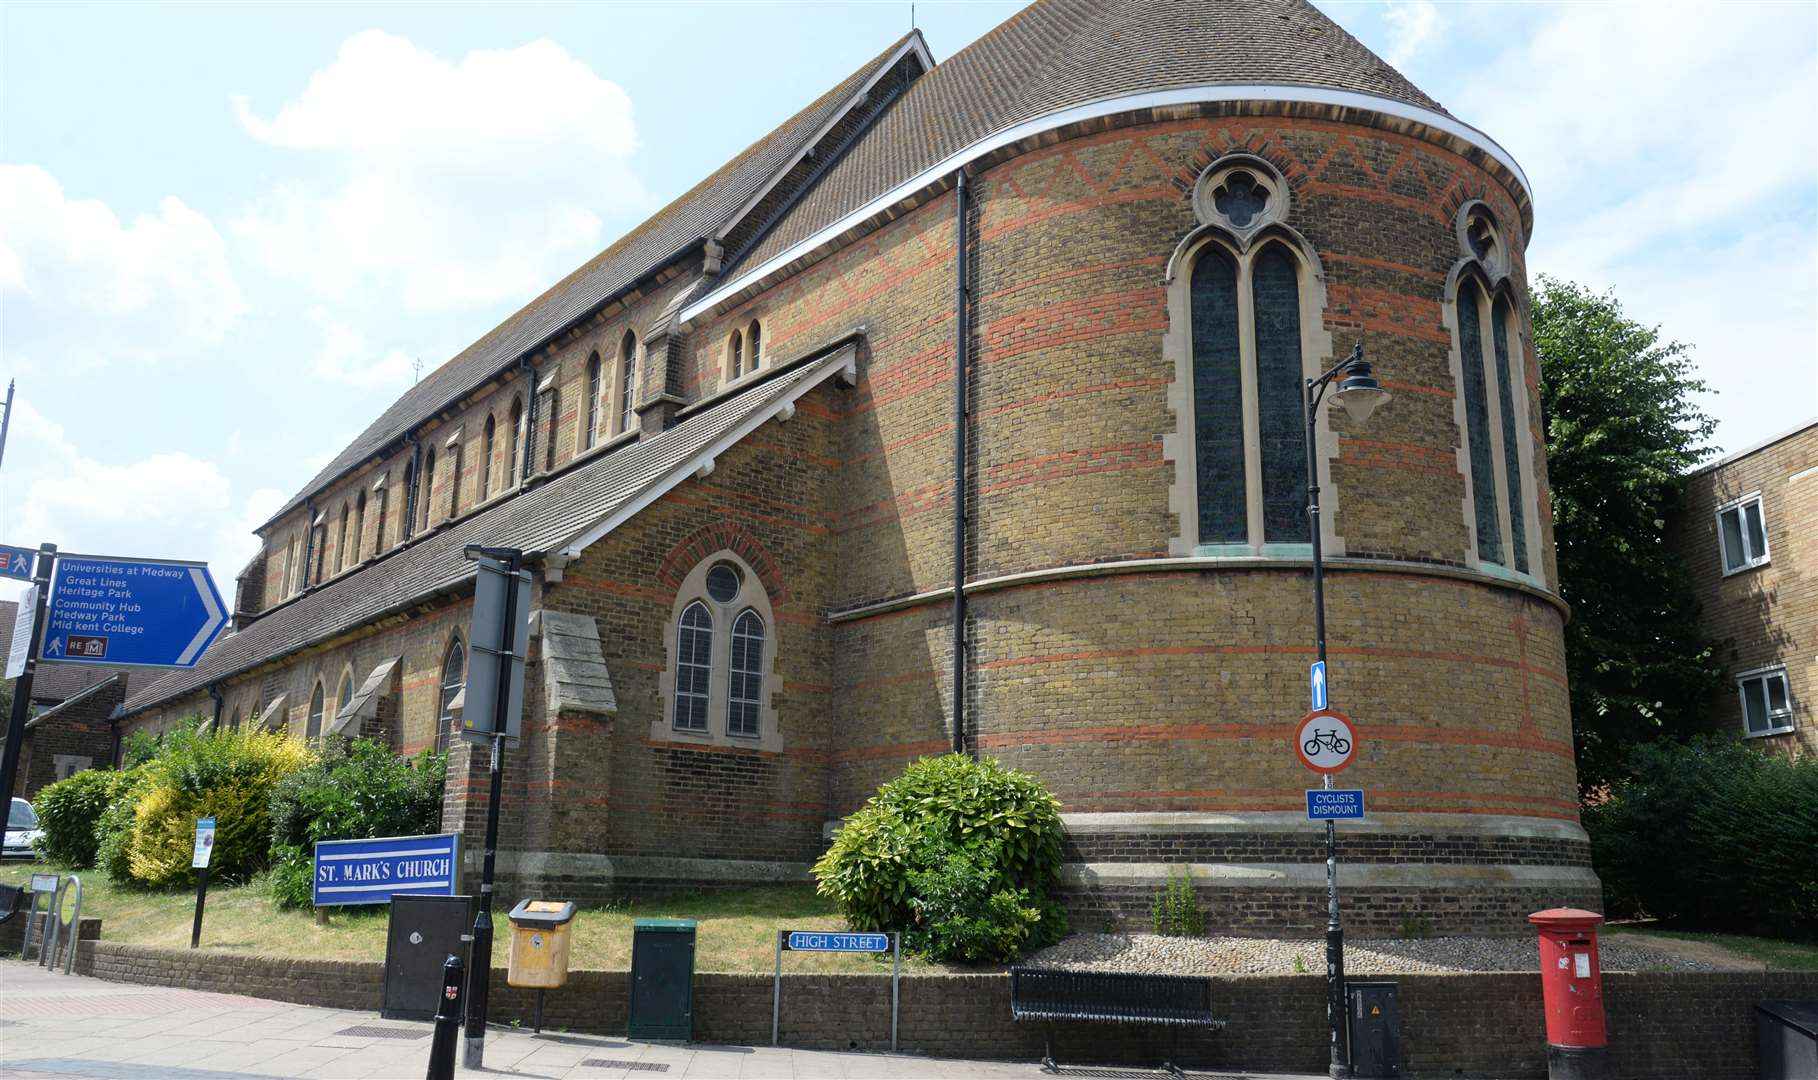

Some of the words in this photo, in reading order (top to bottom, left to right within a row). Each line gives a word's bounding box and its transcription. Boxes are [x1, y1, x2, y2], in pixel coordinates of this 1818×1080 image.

[62, 563, 123, 575] Universities
[127, 567, 137, 575] at
[141, 567, 184, 579] Medway
[66, 575, 96, 586] Great
[100, 577, 127, 588] Lines
[58, 586, 104, 598] Heritage
[108, 588, 132, 599] Park
[55, 599, 115, 612] Community
[119, 602, 141, 612] Hub
[54, 610, 97, 621] Medway
[101, 611, 125, 622] Park
[52, 620, 72, 630] Mid
[76, 622, 99, 631] kent
[103, 622, 144, 635] College
[1315, 794, 1355, 804] CYCLISTS
[1313, 805, 1358, 815] DISMOUNT
[319, 865, 338, 882] ST.
[343, 861, 390, 881] MARK'S
[397, 859, 449, 879] CHURCH
[795, 935, 827, 948] HIGH
[833, 936, 881, 949] STREET
